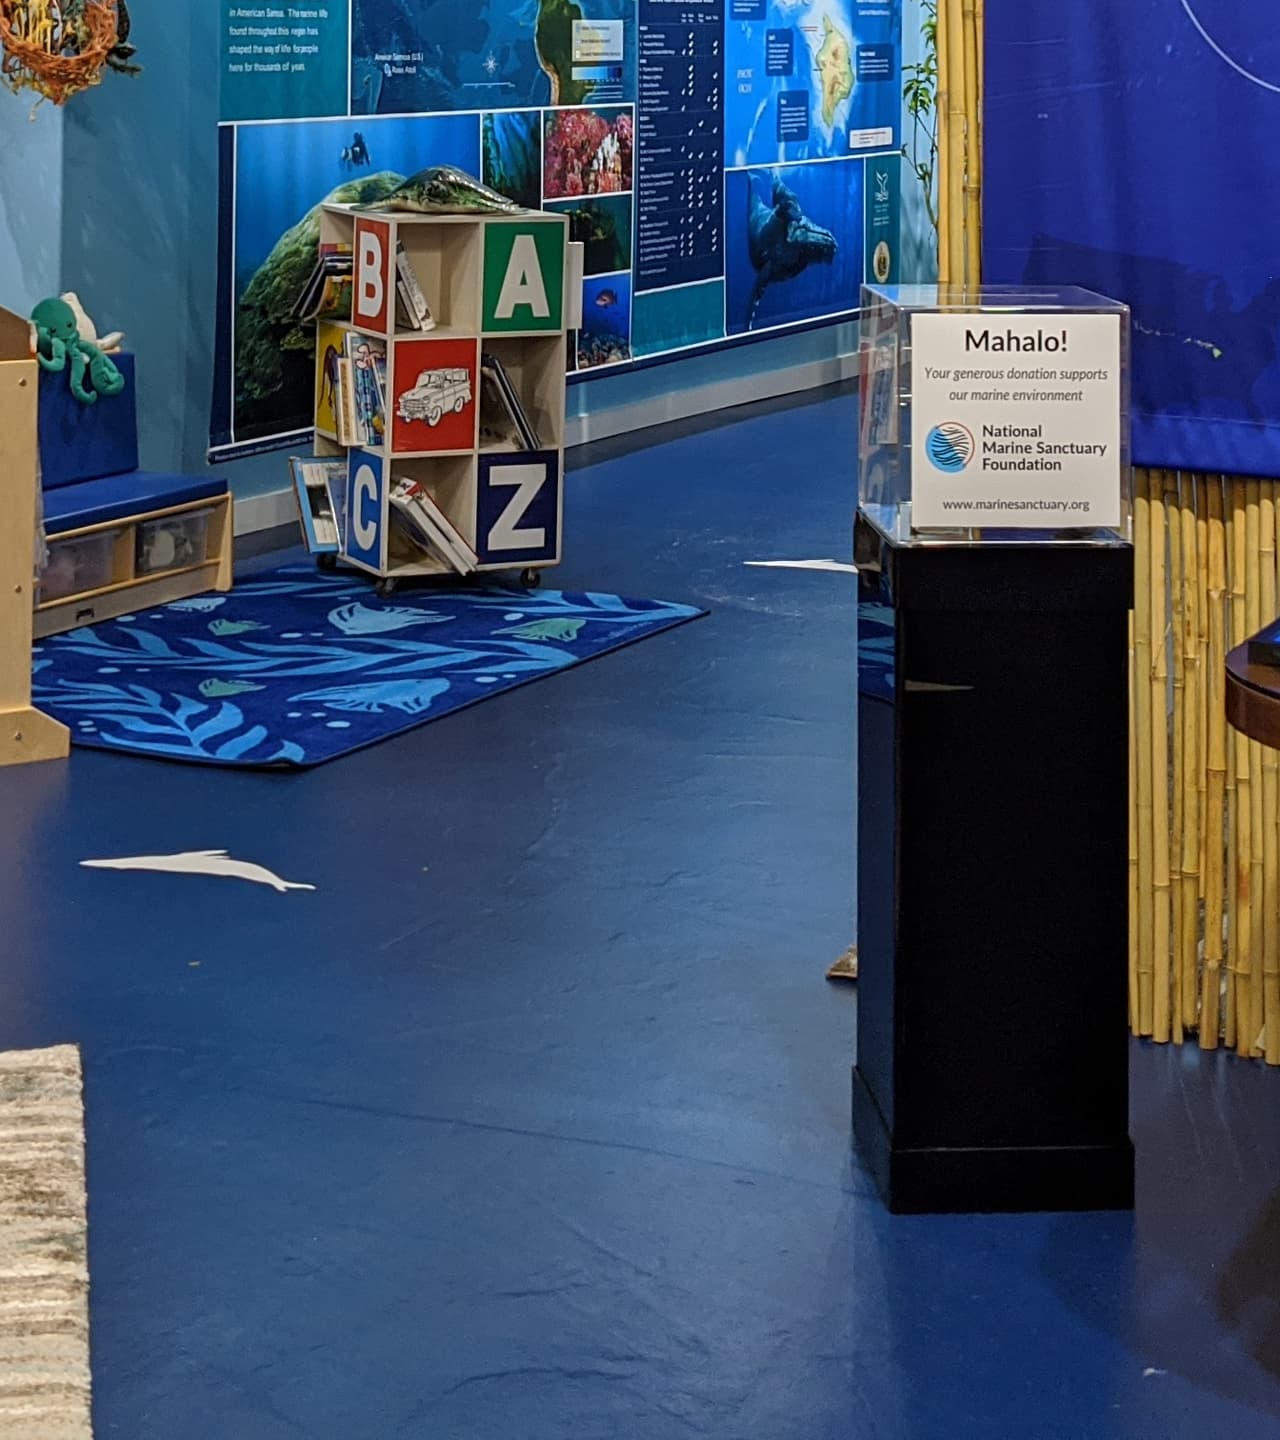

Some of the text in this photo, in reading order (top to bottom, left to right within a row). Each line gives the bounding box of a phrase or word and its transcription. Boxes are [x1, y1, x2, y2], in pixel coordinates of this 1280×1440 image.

[359, 231, 383, 318] B
[493, 234, 550, 319] A
[966, 330, 1066, 352] Mahalo!
[925, 368, 1107, 382] Your generous donation supports
[949, 389, 1083, 401] our marine environment
[983, 425, 1041, 437] National
[983, 441, 1106, 456] Marine Sanctuary
[983, 458, 1061, 470] Foundation
[353, 464, 377, 551] C
[487, 464, 547, 551] Z
[943, 499, 1089, 512] www.marinesanctuary.org
